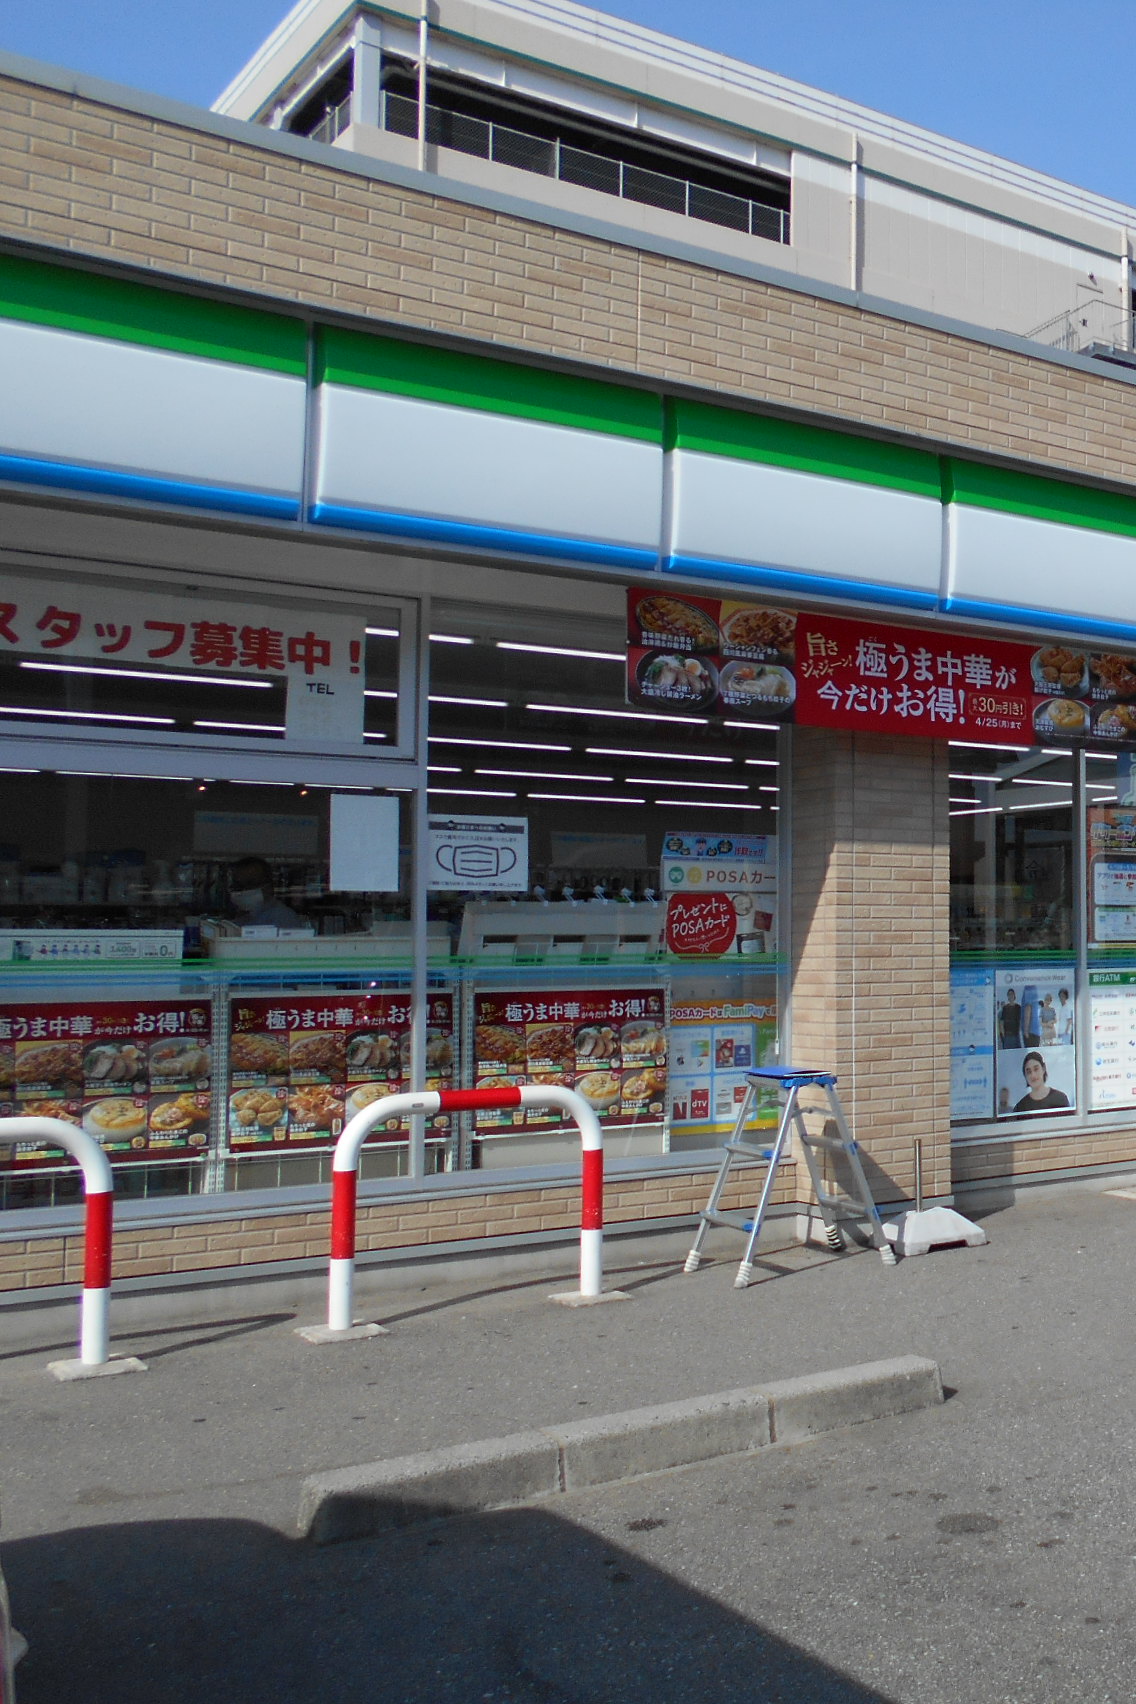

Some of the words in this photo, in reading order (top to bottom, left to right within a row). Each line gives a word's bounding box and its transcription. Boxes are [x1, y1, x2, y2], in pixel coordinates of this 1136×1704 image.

[856, 638, 1017, 690] 極うま中華が
[306, 683, 335, 695] TEL
[817, 680, 966, 725] 今だけお得!
[672, 914, 730, 939] POSAカード
[692, 1100, 708, 1108] dTV
